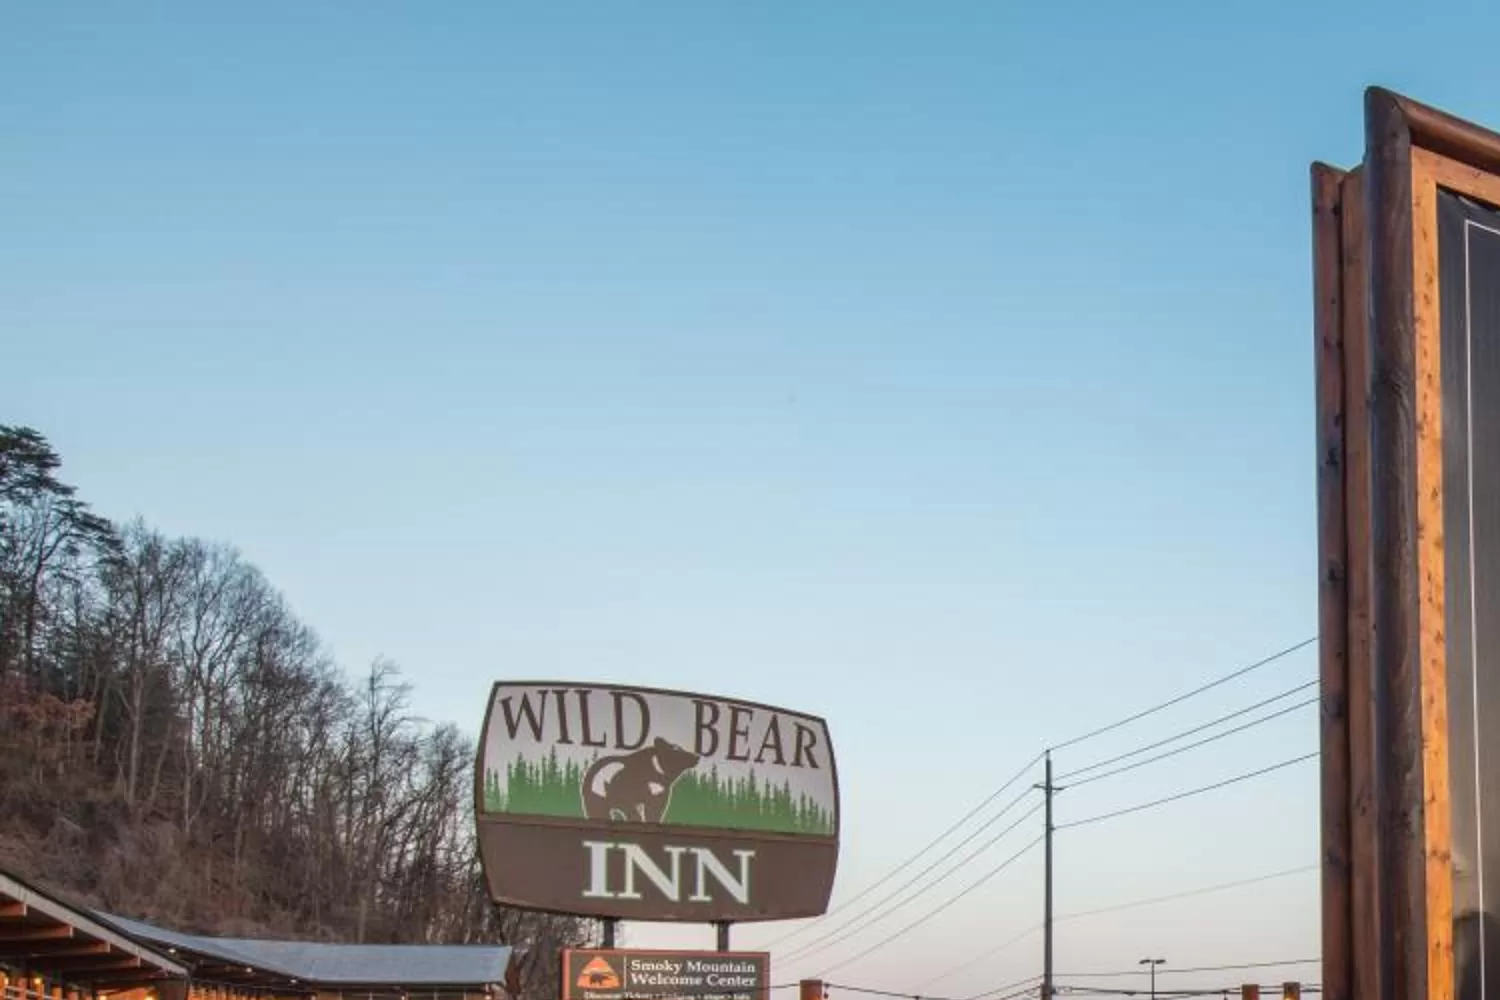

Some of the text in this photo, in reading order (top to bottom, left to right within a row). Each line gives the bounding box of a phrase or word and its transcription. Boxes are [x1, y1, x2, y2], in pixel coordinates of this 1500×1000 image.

[499, 688, 820, 770] WILD BEAR
[581, 839, 756, 905] INN
[630, 959, 756, 975] Smoky Mountain
[630, 973, 757, 987] Welcome Center
